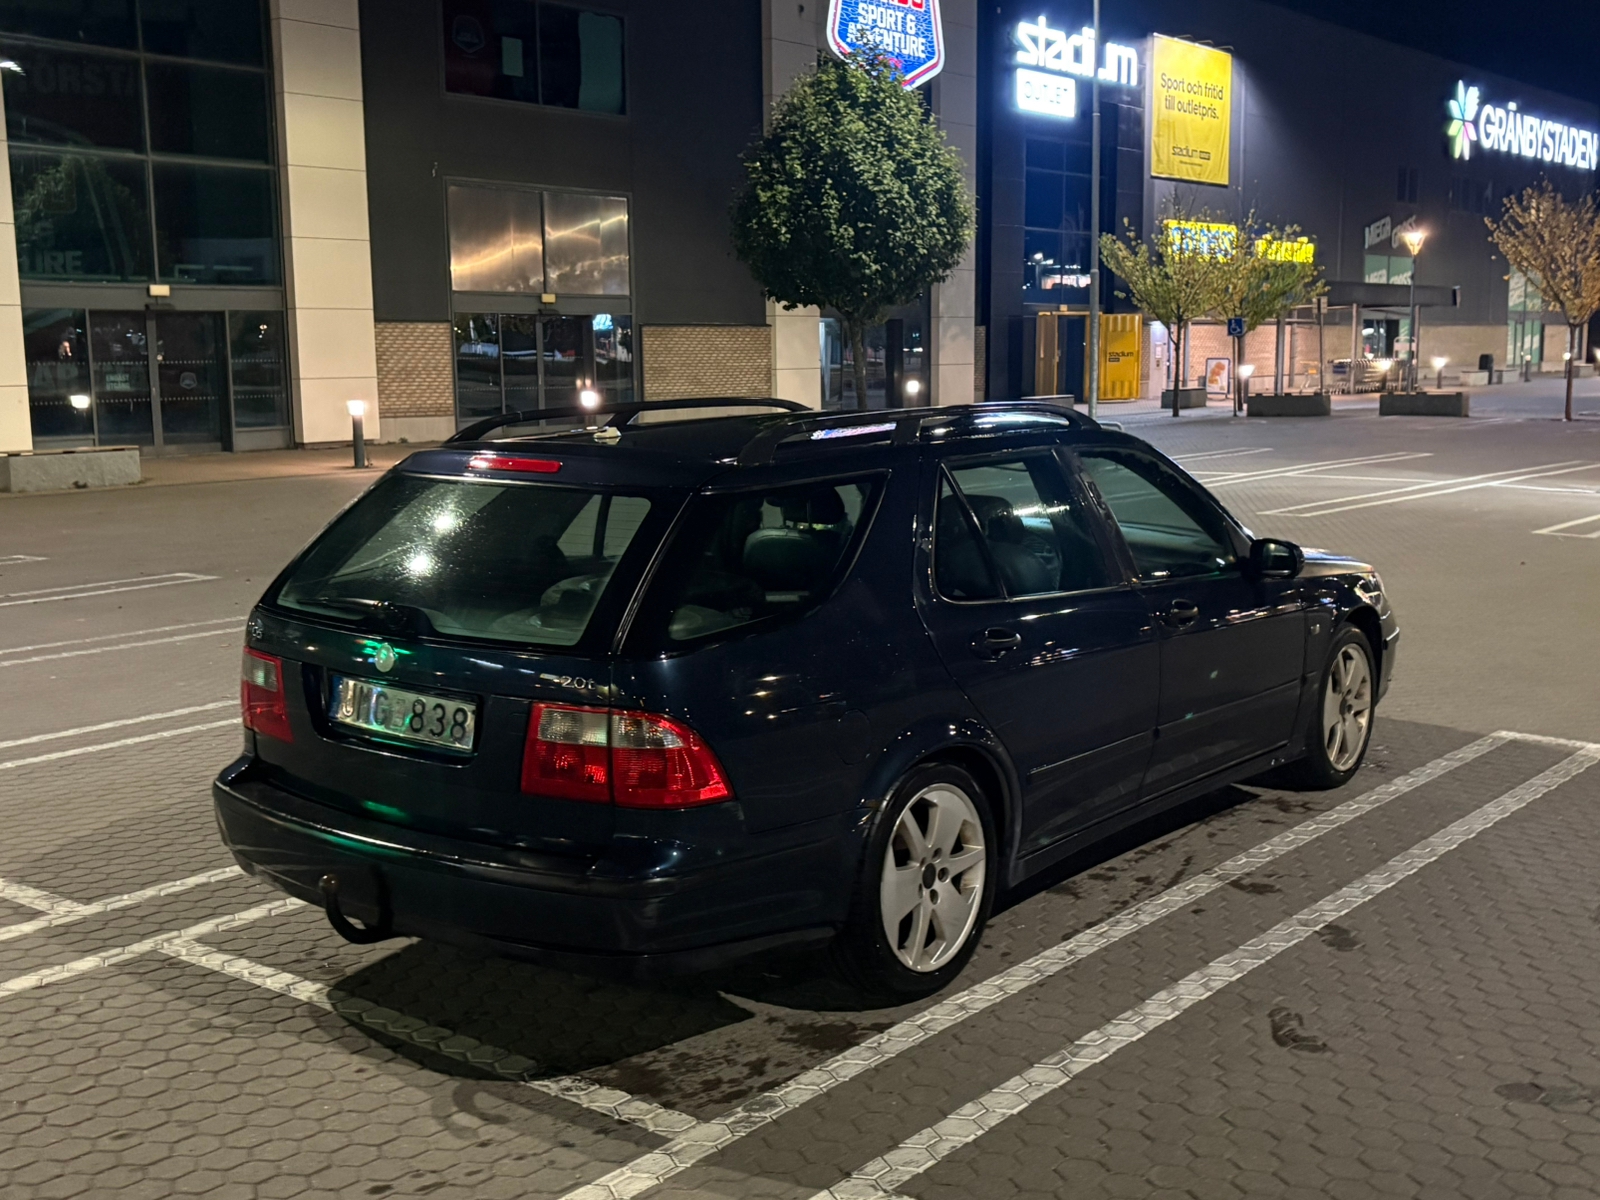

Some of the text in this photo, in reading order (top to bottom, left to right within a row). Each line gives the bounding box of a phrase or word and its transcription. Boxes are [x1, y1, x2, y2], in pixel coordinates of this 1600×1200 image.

[858, 3, 917, 35] SPORT &
[1024, 81, 1068, 105] OUTLET
[1161, 72, 1224, 101] Sport och fritid
[1165, 95, 1219, 121] till outletpris.
[1365, 216, 1391, 249] MEGA
[409, 698, 469, 743] 838
